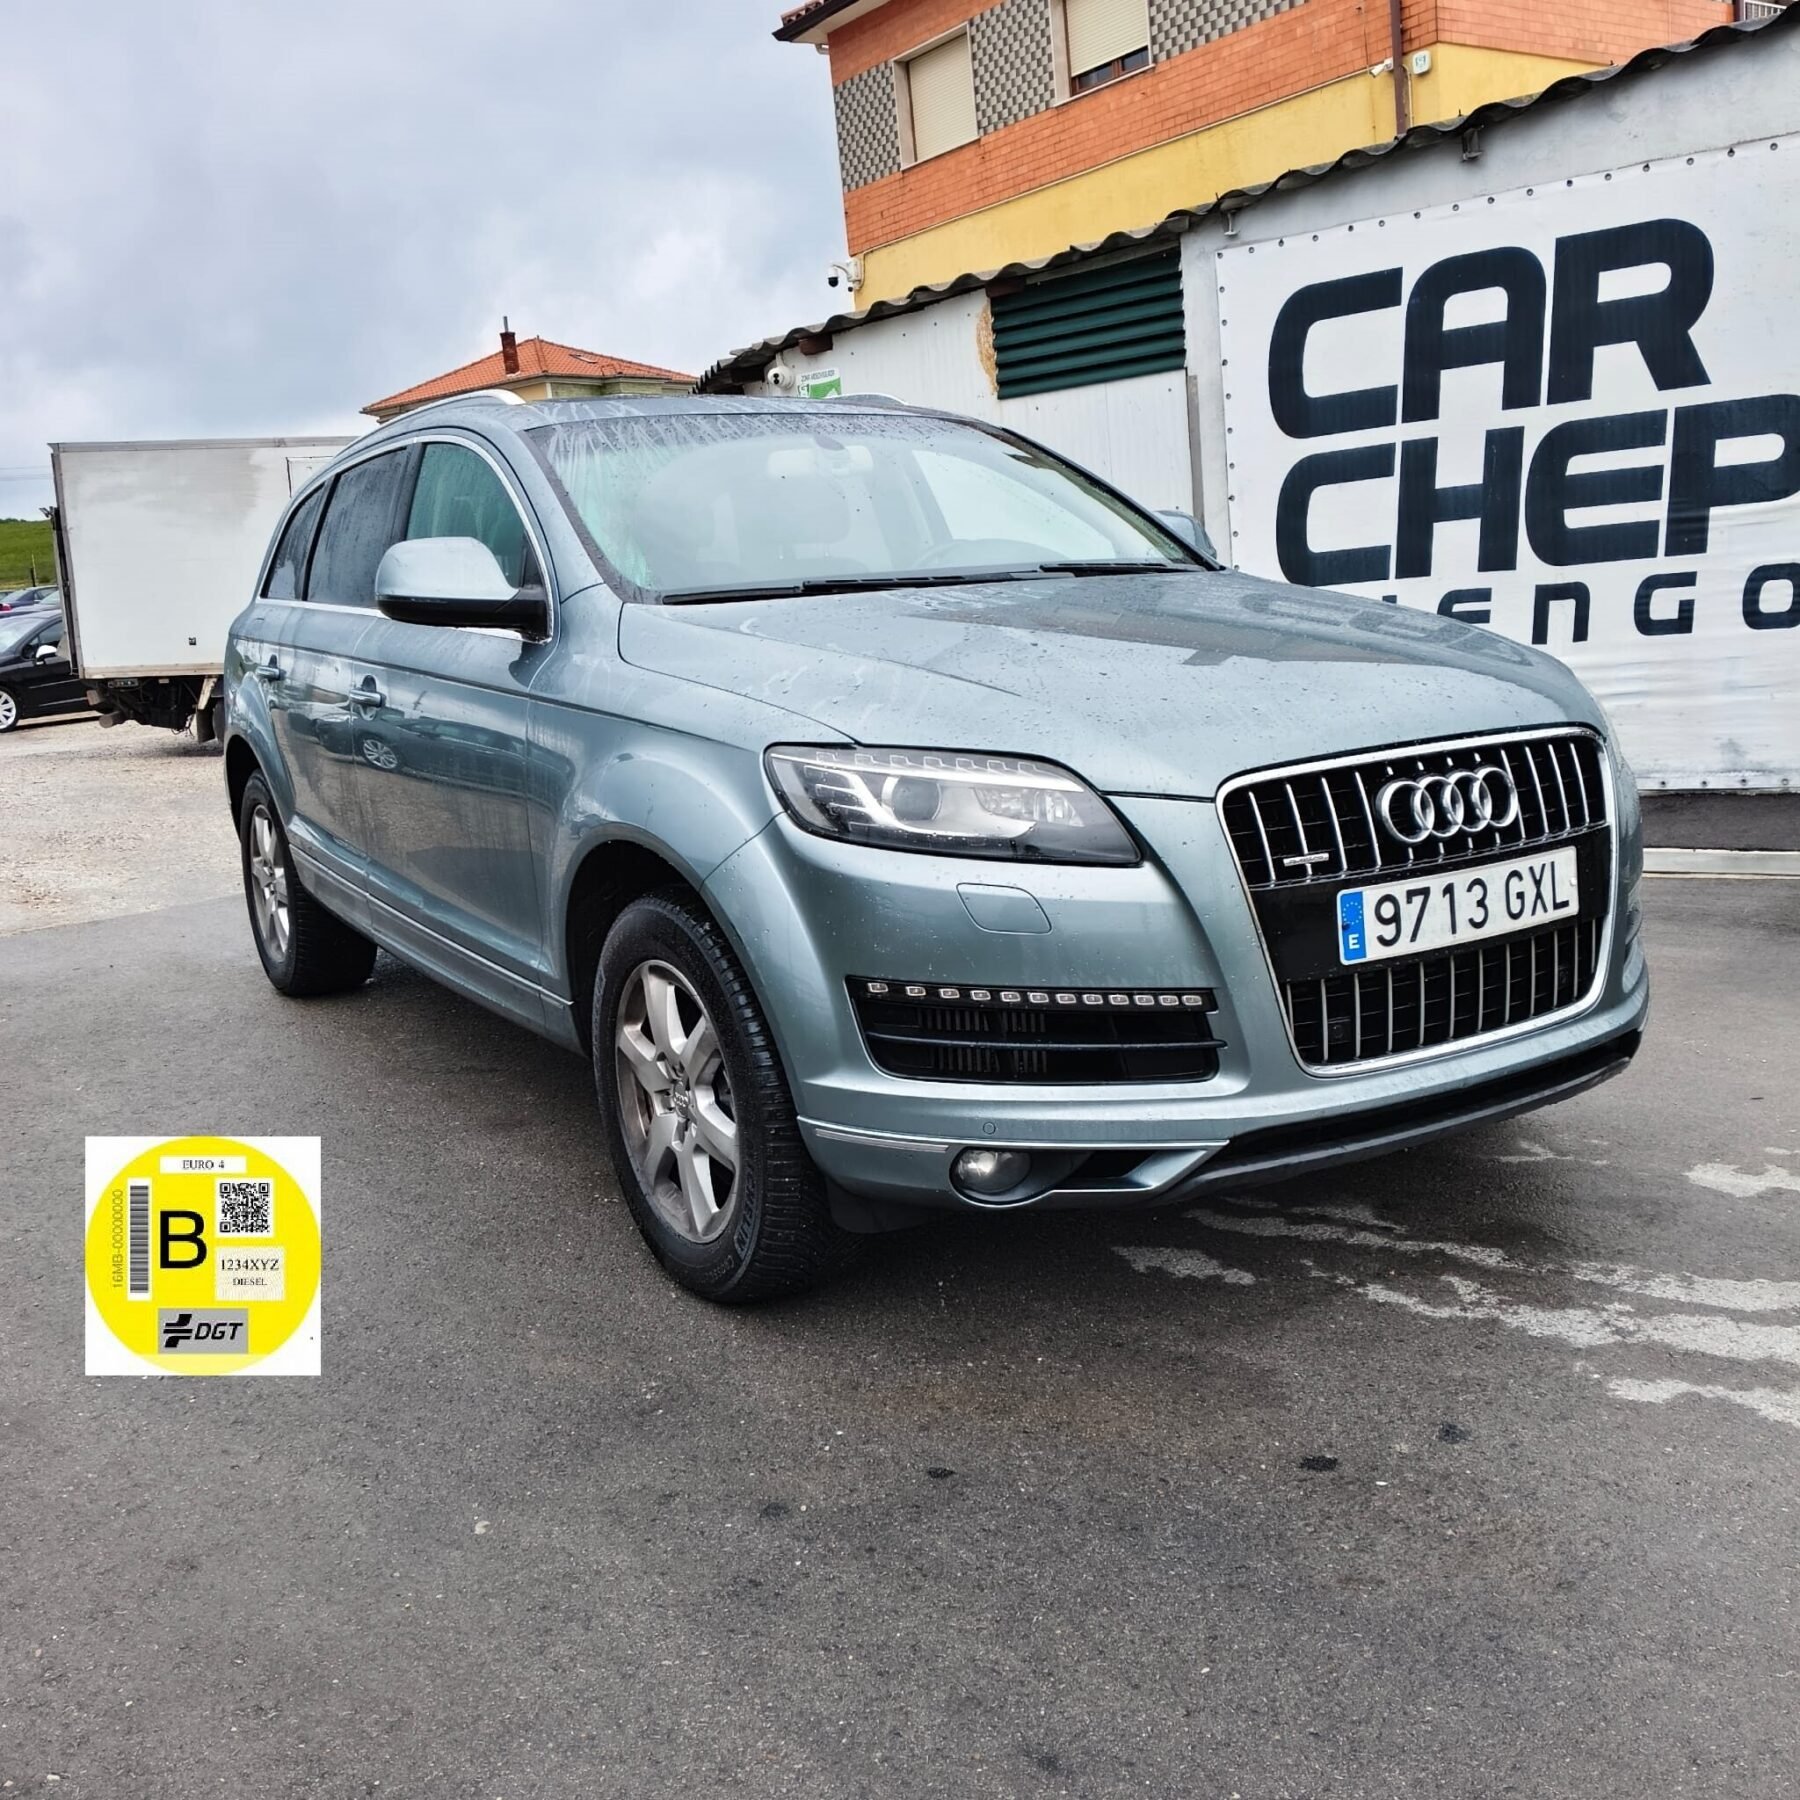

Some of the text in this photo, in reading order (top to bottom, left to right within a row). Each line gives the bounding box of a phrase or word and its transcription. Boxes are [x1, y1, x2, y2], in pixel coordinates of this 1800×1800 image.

[1268, 218, 1715, 439] CAR
[1275, 394, 1800, 587] CHEP
[1349, 934, 1359, 950] E
[1375, 861, 1569, 947] 9713 GXL
